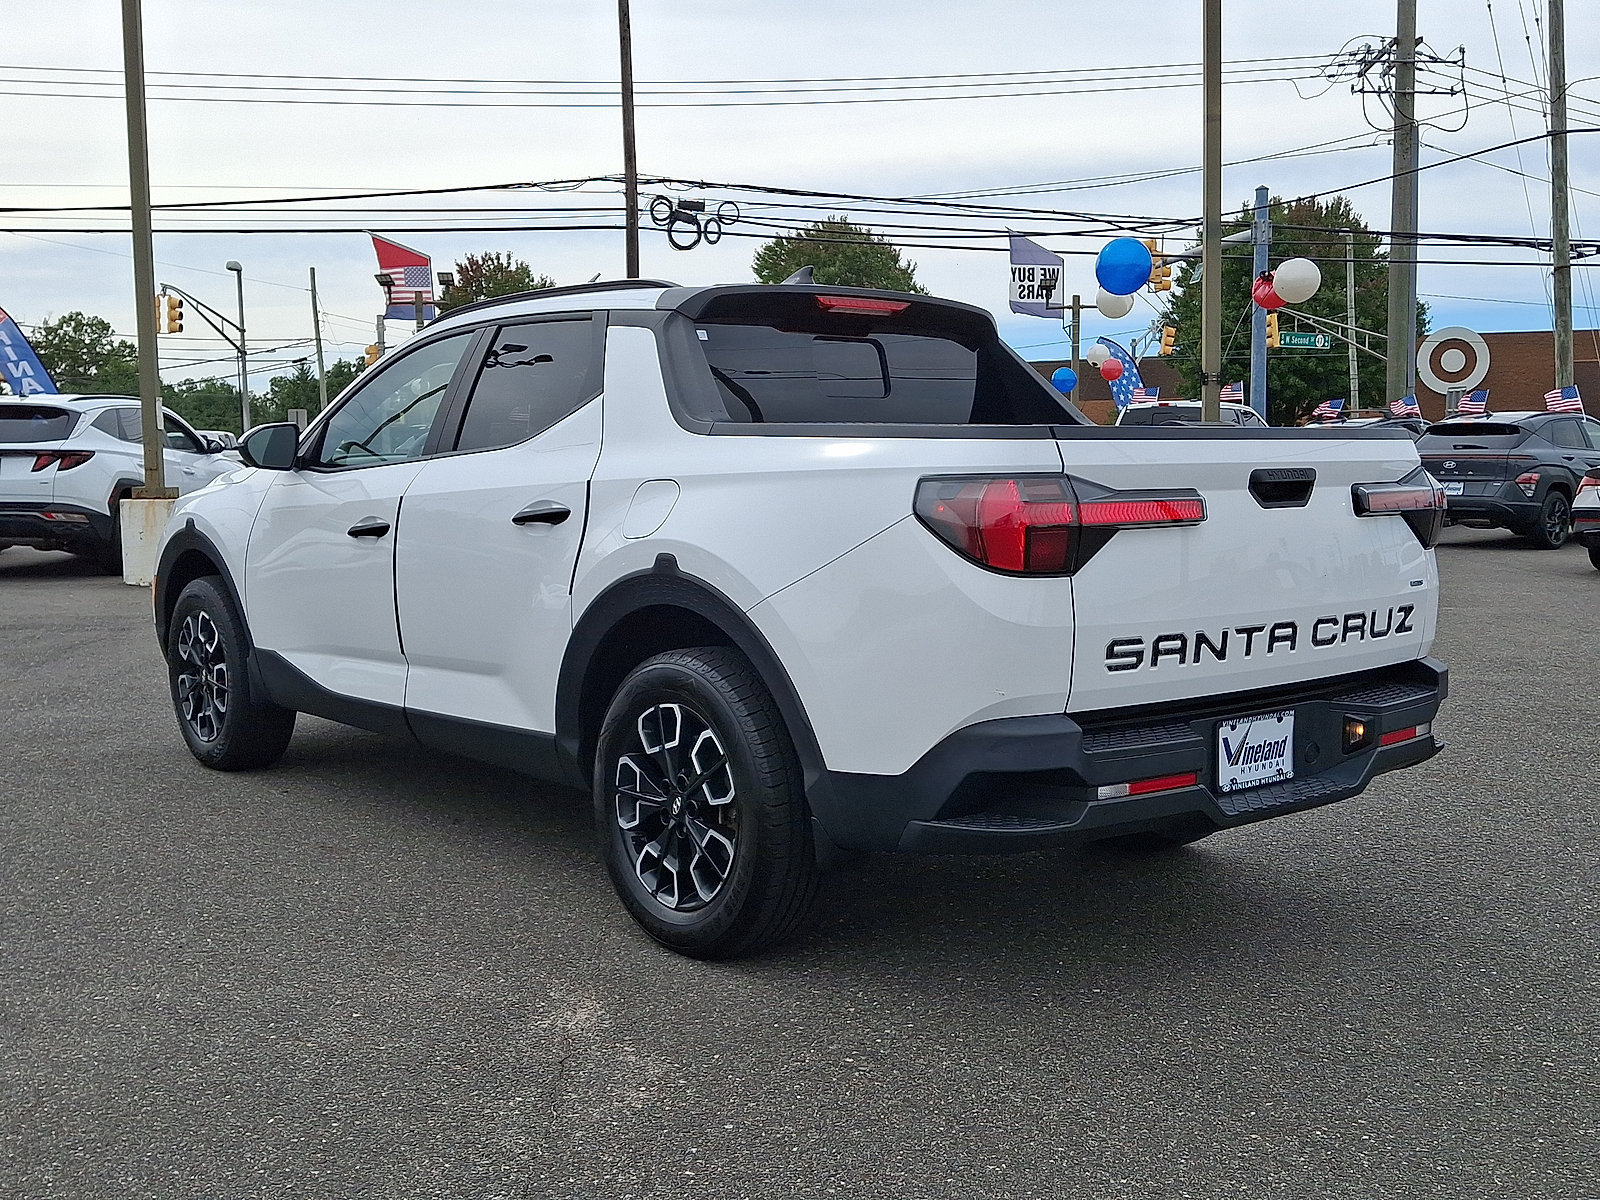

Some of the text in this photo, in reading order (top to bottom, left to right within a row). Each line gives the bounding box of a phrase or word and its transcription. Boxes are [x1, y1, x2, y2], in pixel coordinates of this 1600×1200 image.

[1291, 336, 1309, 345] Second
[1266, 469, 1311, 481] HYUNDAI
[1105, 603, 1416, 673] SANTA CRUZ
[1221, 722, 1288, 768] Vineland
[1241, 759, 1285, 774] HYUNDAI
[1261, 774, 1286, 784] HYUNDAI
